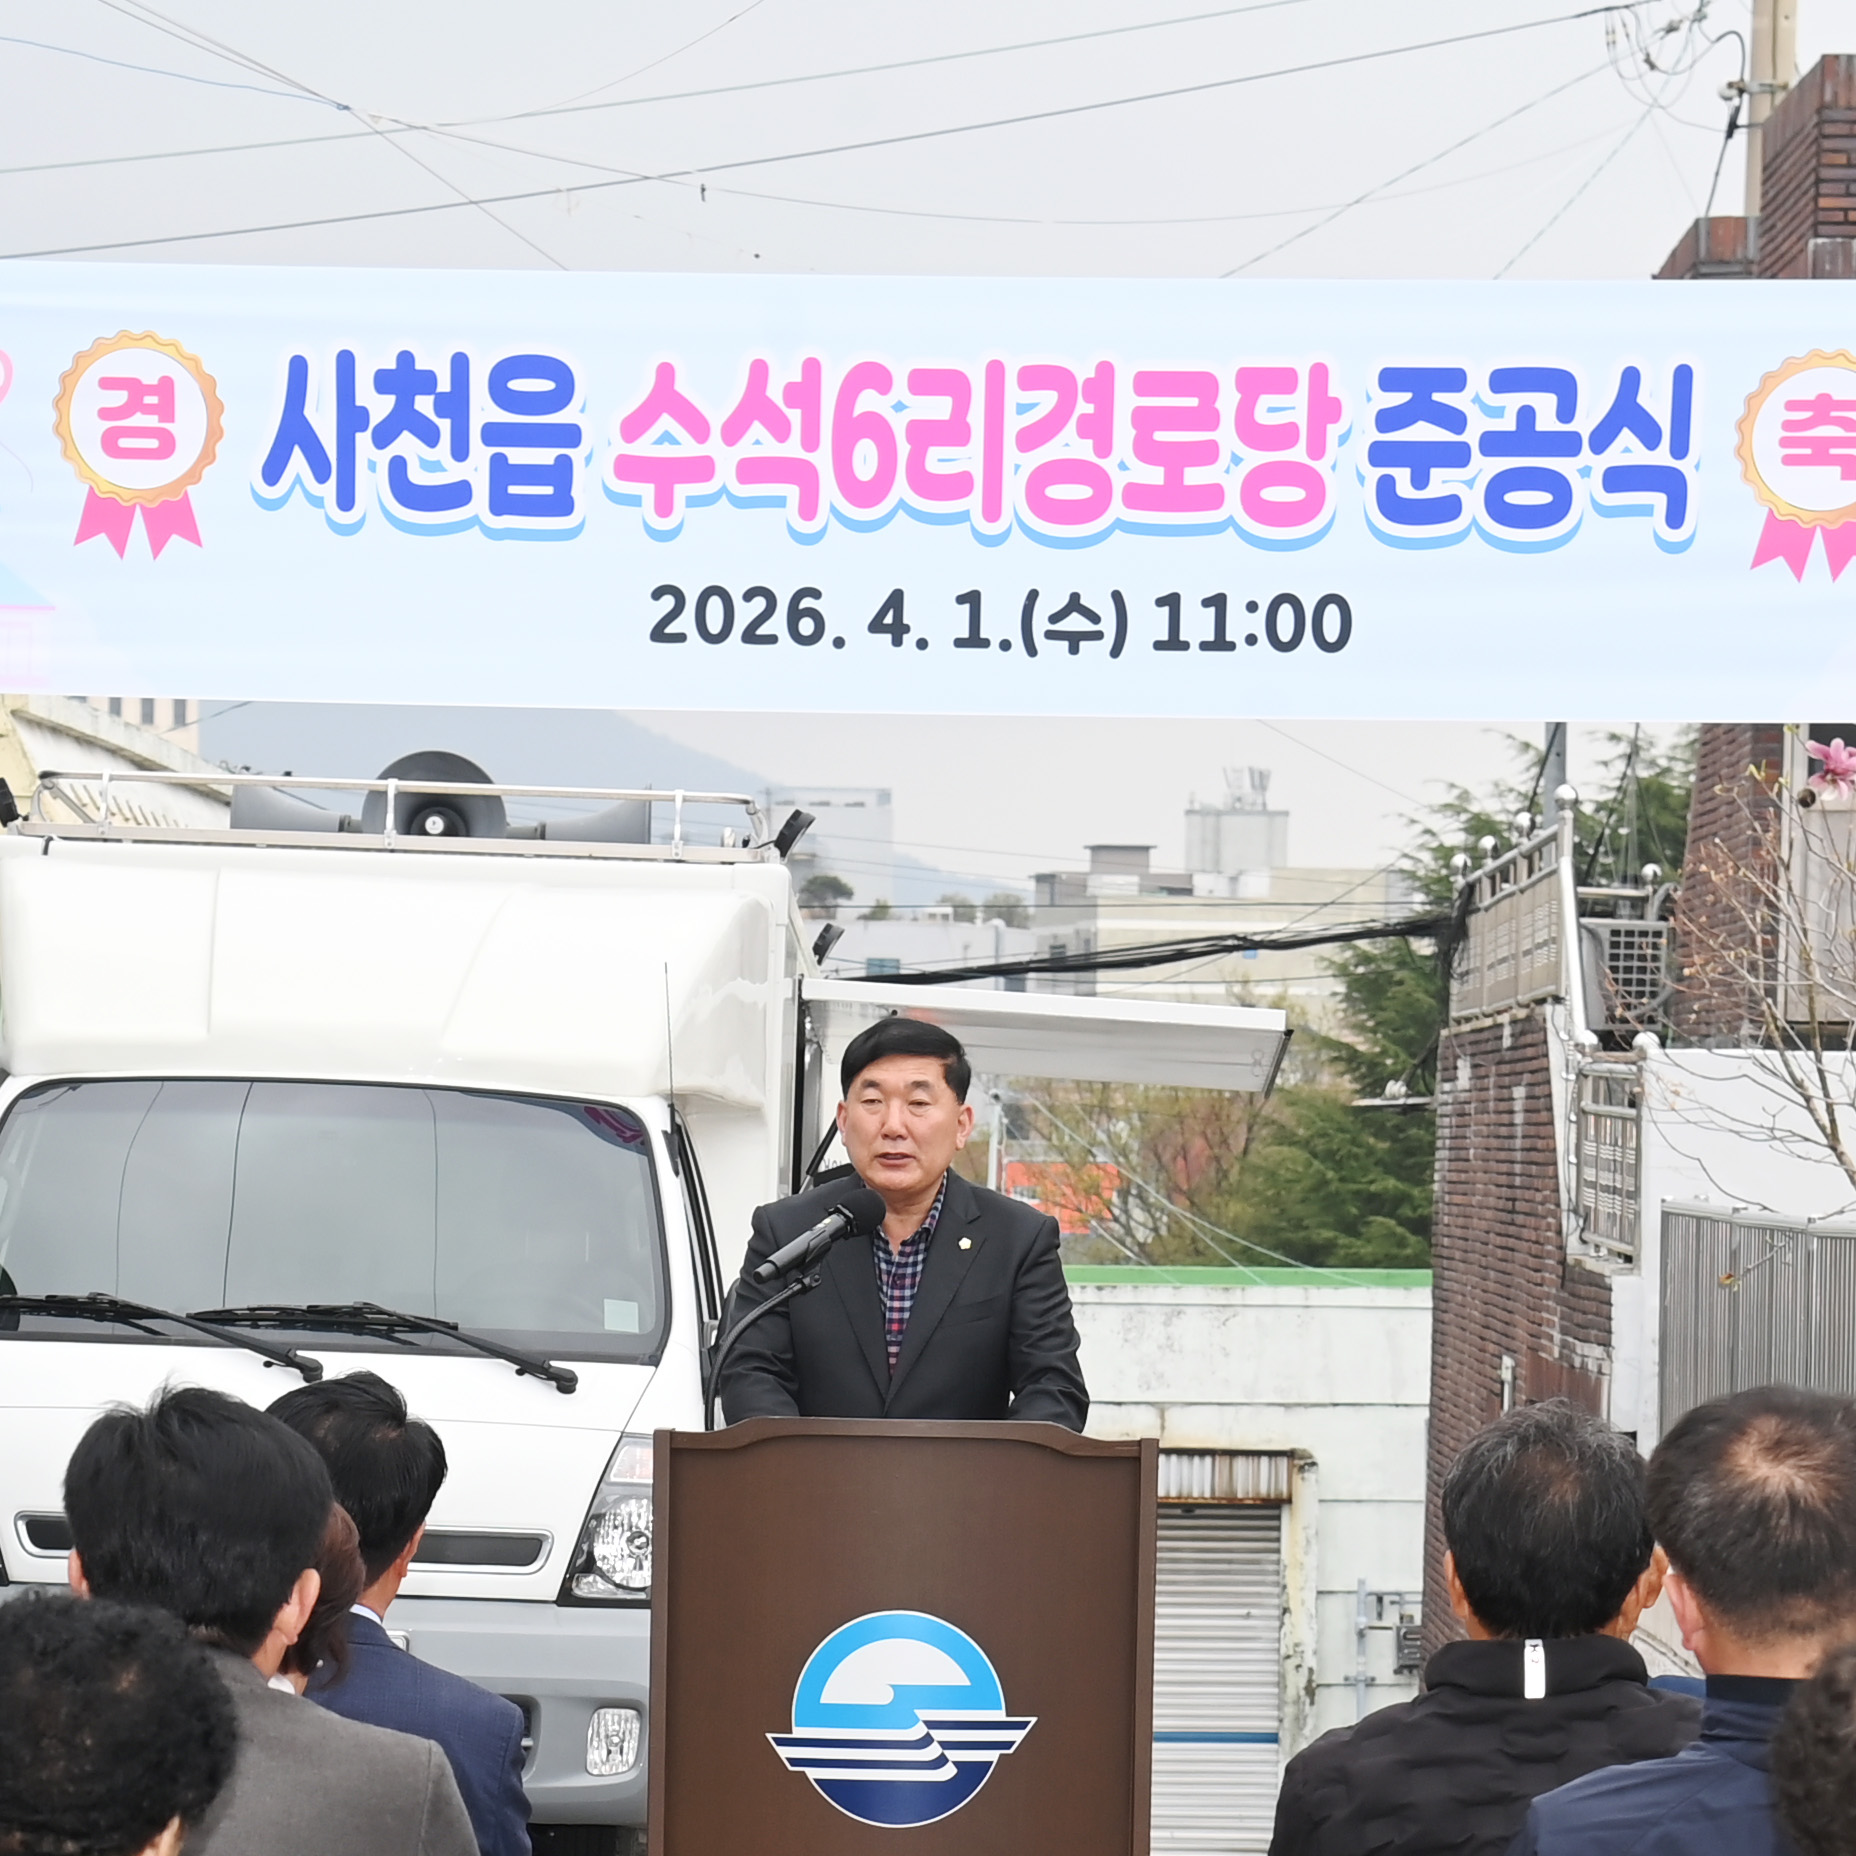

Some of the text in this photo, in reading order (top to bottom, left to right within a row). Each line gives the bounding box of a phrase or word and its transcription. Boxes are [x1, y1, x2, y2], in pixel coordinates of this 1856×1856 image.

[97, 374, 176, 461] 경
[261, 349, 1694, 530] 사천읍 수석6리경로당 준공식
[649, 584, 847, 648] 2026.
[867, 588, 930, 652] 4.
[1152, 591, 1354, 654] 11:00
